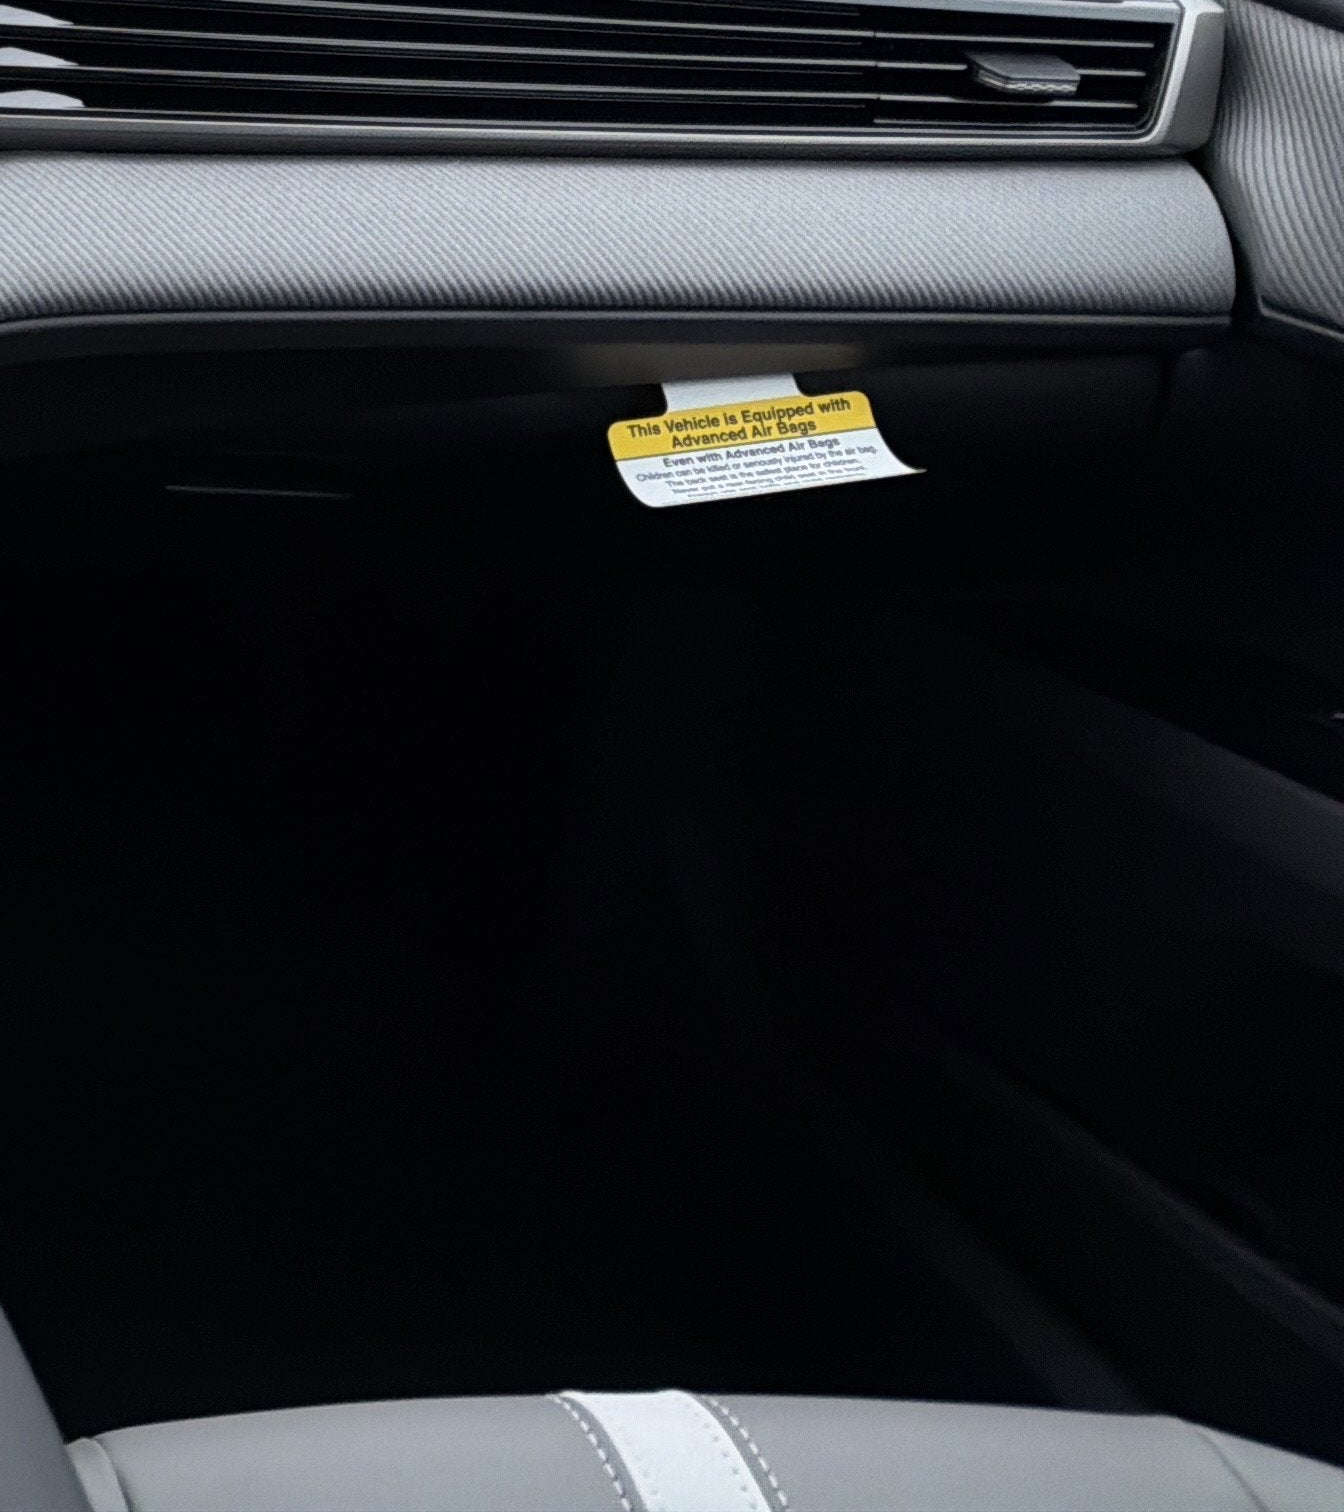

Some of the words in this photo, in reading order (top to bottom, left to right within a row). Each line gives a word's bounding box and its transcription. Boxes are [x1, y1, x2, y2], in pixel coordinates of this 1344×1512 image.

[627, 423, 661, 438] This
[663, 414, 720, 434] Vehicle
[723, 410, 738, 426] is
[742, 402, 815, 426] Equipped
[818, 398, 851, 414] with
[672, 426, 747, 449] Advanced
[751, 423, 773, 439] Air
[778, 419, 817, 438] Bags
[636, 470, 675, 483] Children
[675, 469, 692, 479] can
[692, 466, 707, 476] be
[707, 462, 732, 475] killed
[733, 462, 742, 471] or
[743, 456, 784, 473] seriously
[784, 451, 815, 466] injured
[816, 450, 828, 462] by
[663, 456, 694, 468] Even
[696, 452, 723, 464] with
[725, 443, 785, 460] Advanced
[788, 441, 807, 454] Air
[807, 437, 841, 453] Bags
